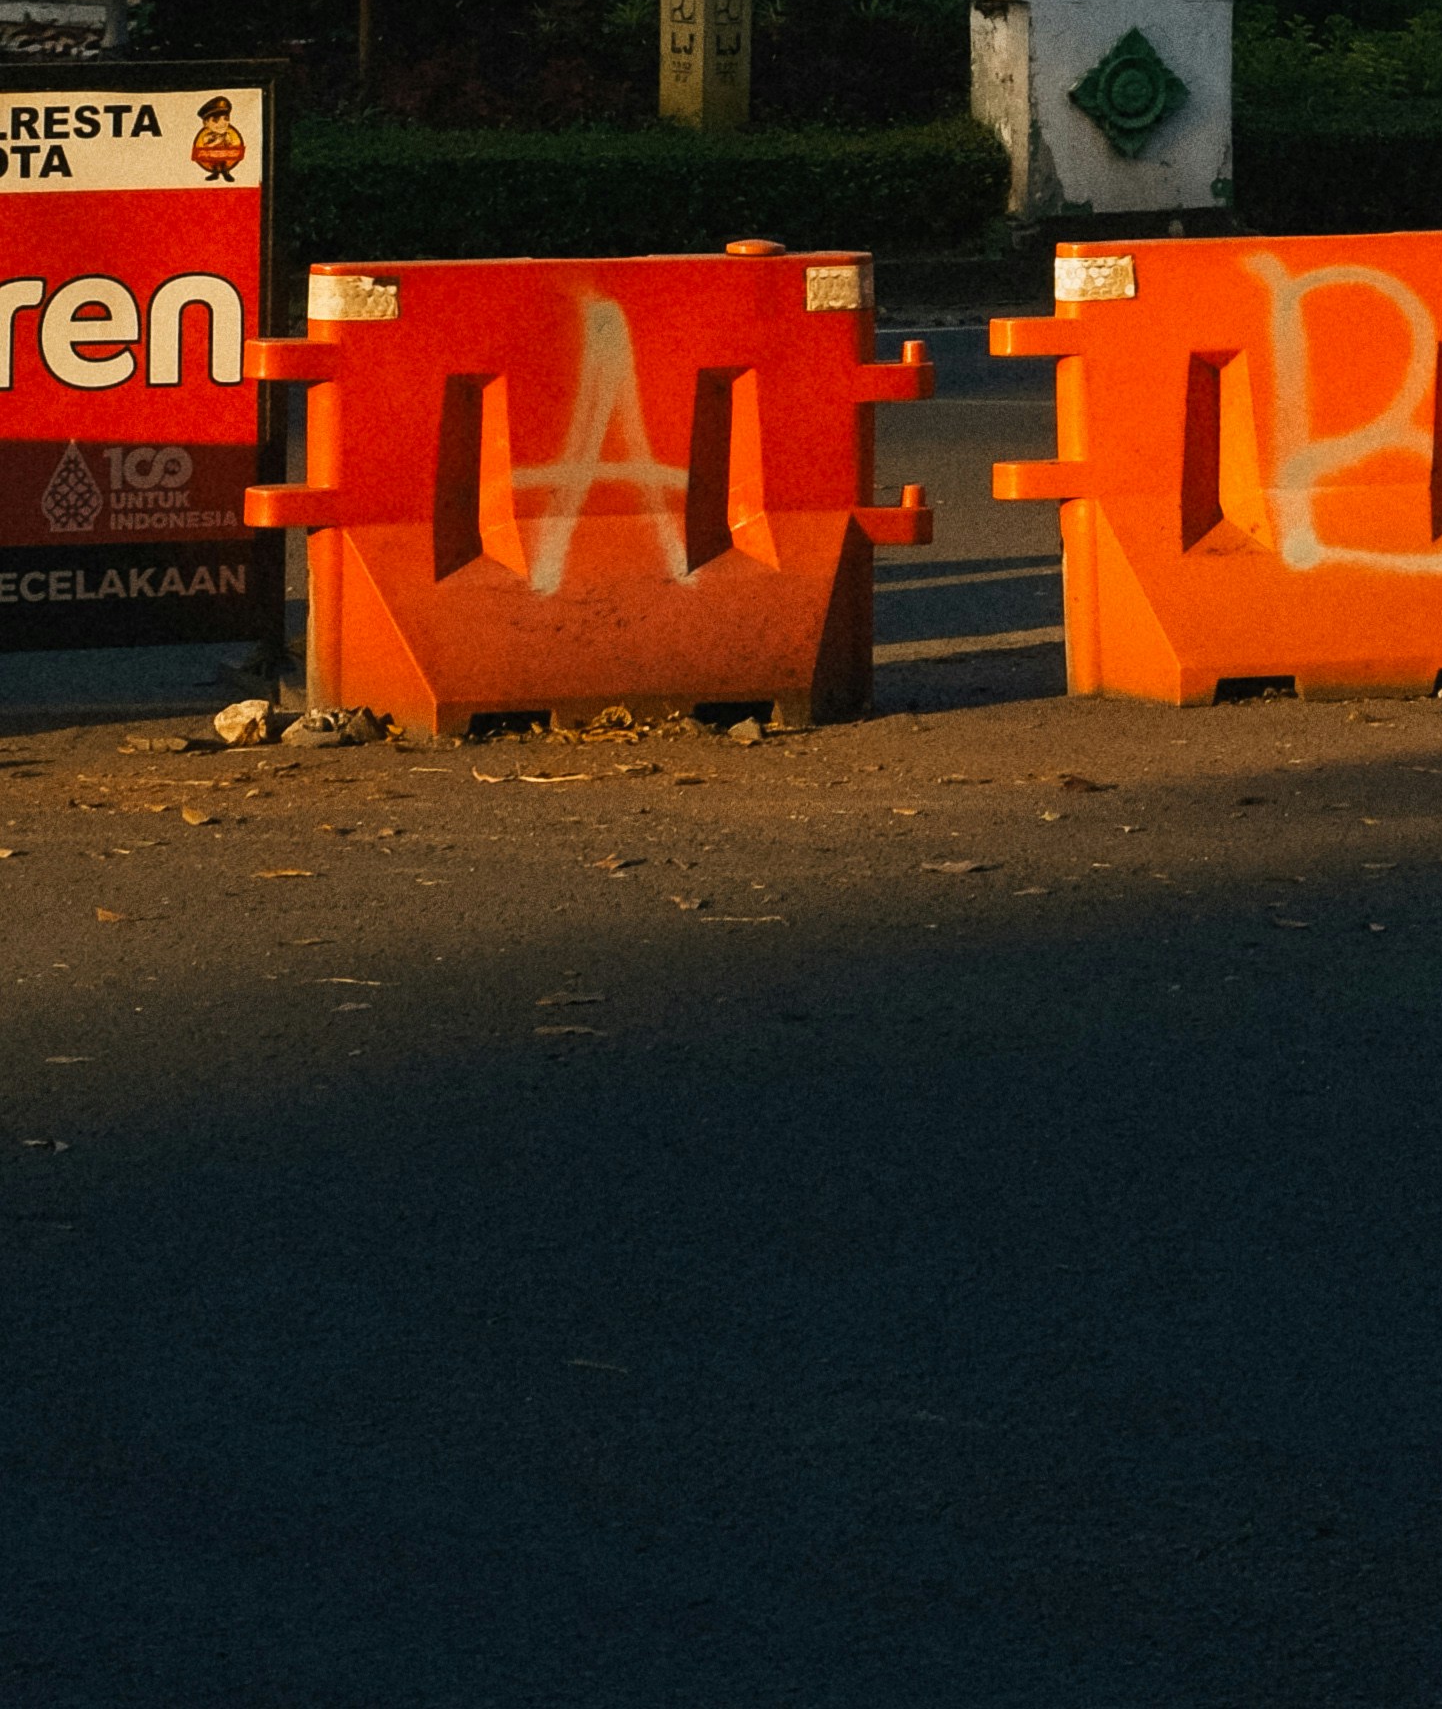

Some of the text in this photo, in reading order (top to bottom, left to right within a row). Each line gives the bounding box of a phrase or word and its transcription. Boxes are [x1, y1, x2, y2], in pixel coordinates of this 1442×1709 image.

[0, 104, 163, 140] RESTA
[0, 144, 73, 179] TA
[104, 445, 194, 490] 100
[110, 490, 191, 510] UNTUK
[110, 510, 238, 531] INDONESIA
